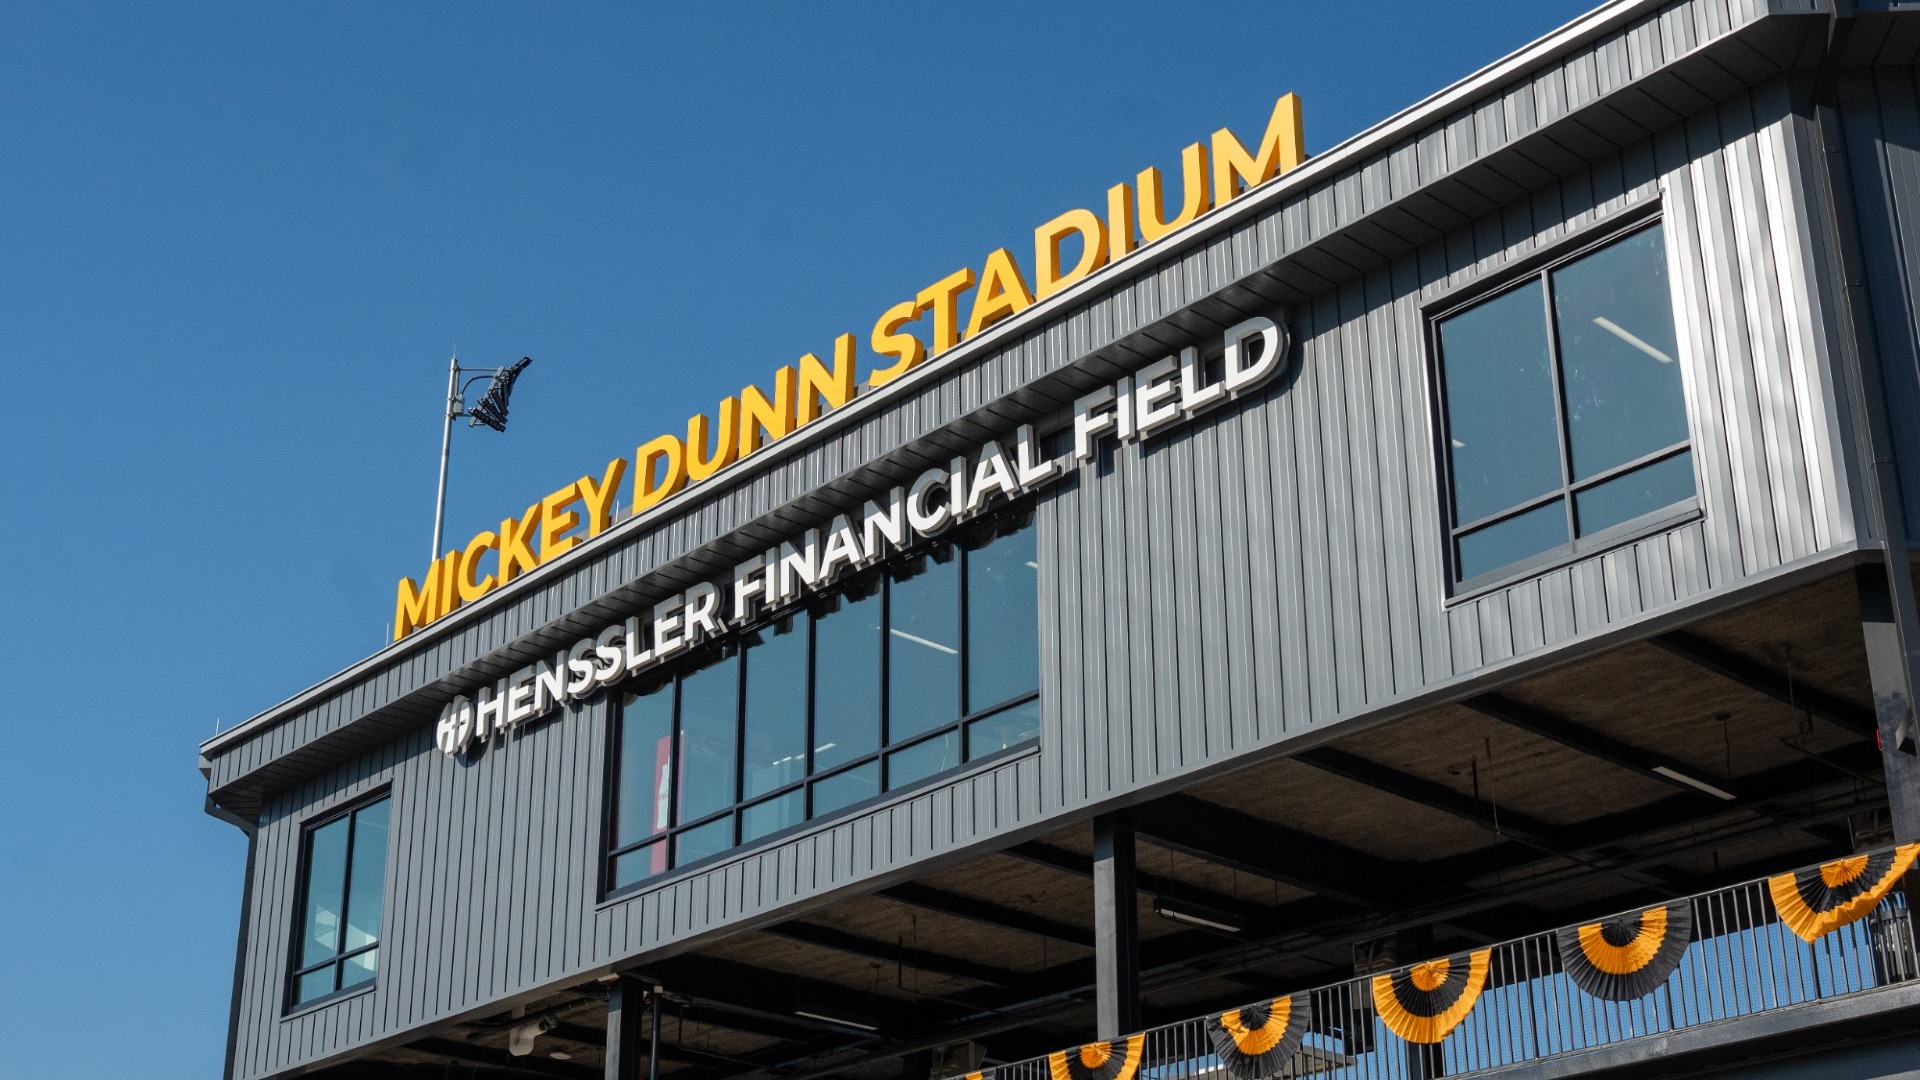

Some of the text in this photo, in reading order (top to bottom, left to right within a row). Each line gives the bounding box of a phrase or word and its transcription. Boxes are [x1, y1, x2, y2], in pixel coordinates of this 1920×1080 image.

[393, 91, 1304, 641] MICKEY DUNN STADIUM
[476, 581, 727, 743] HENSSLER
[734, 424, 1057, 622] FINANCIAL
[1073, 316, 1289, 460] FIELD
